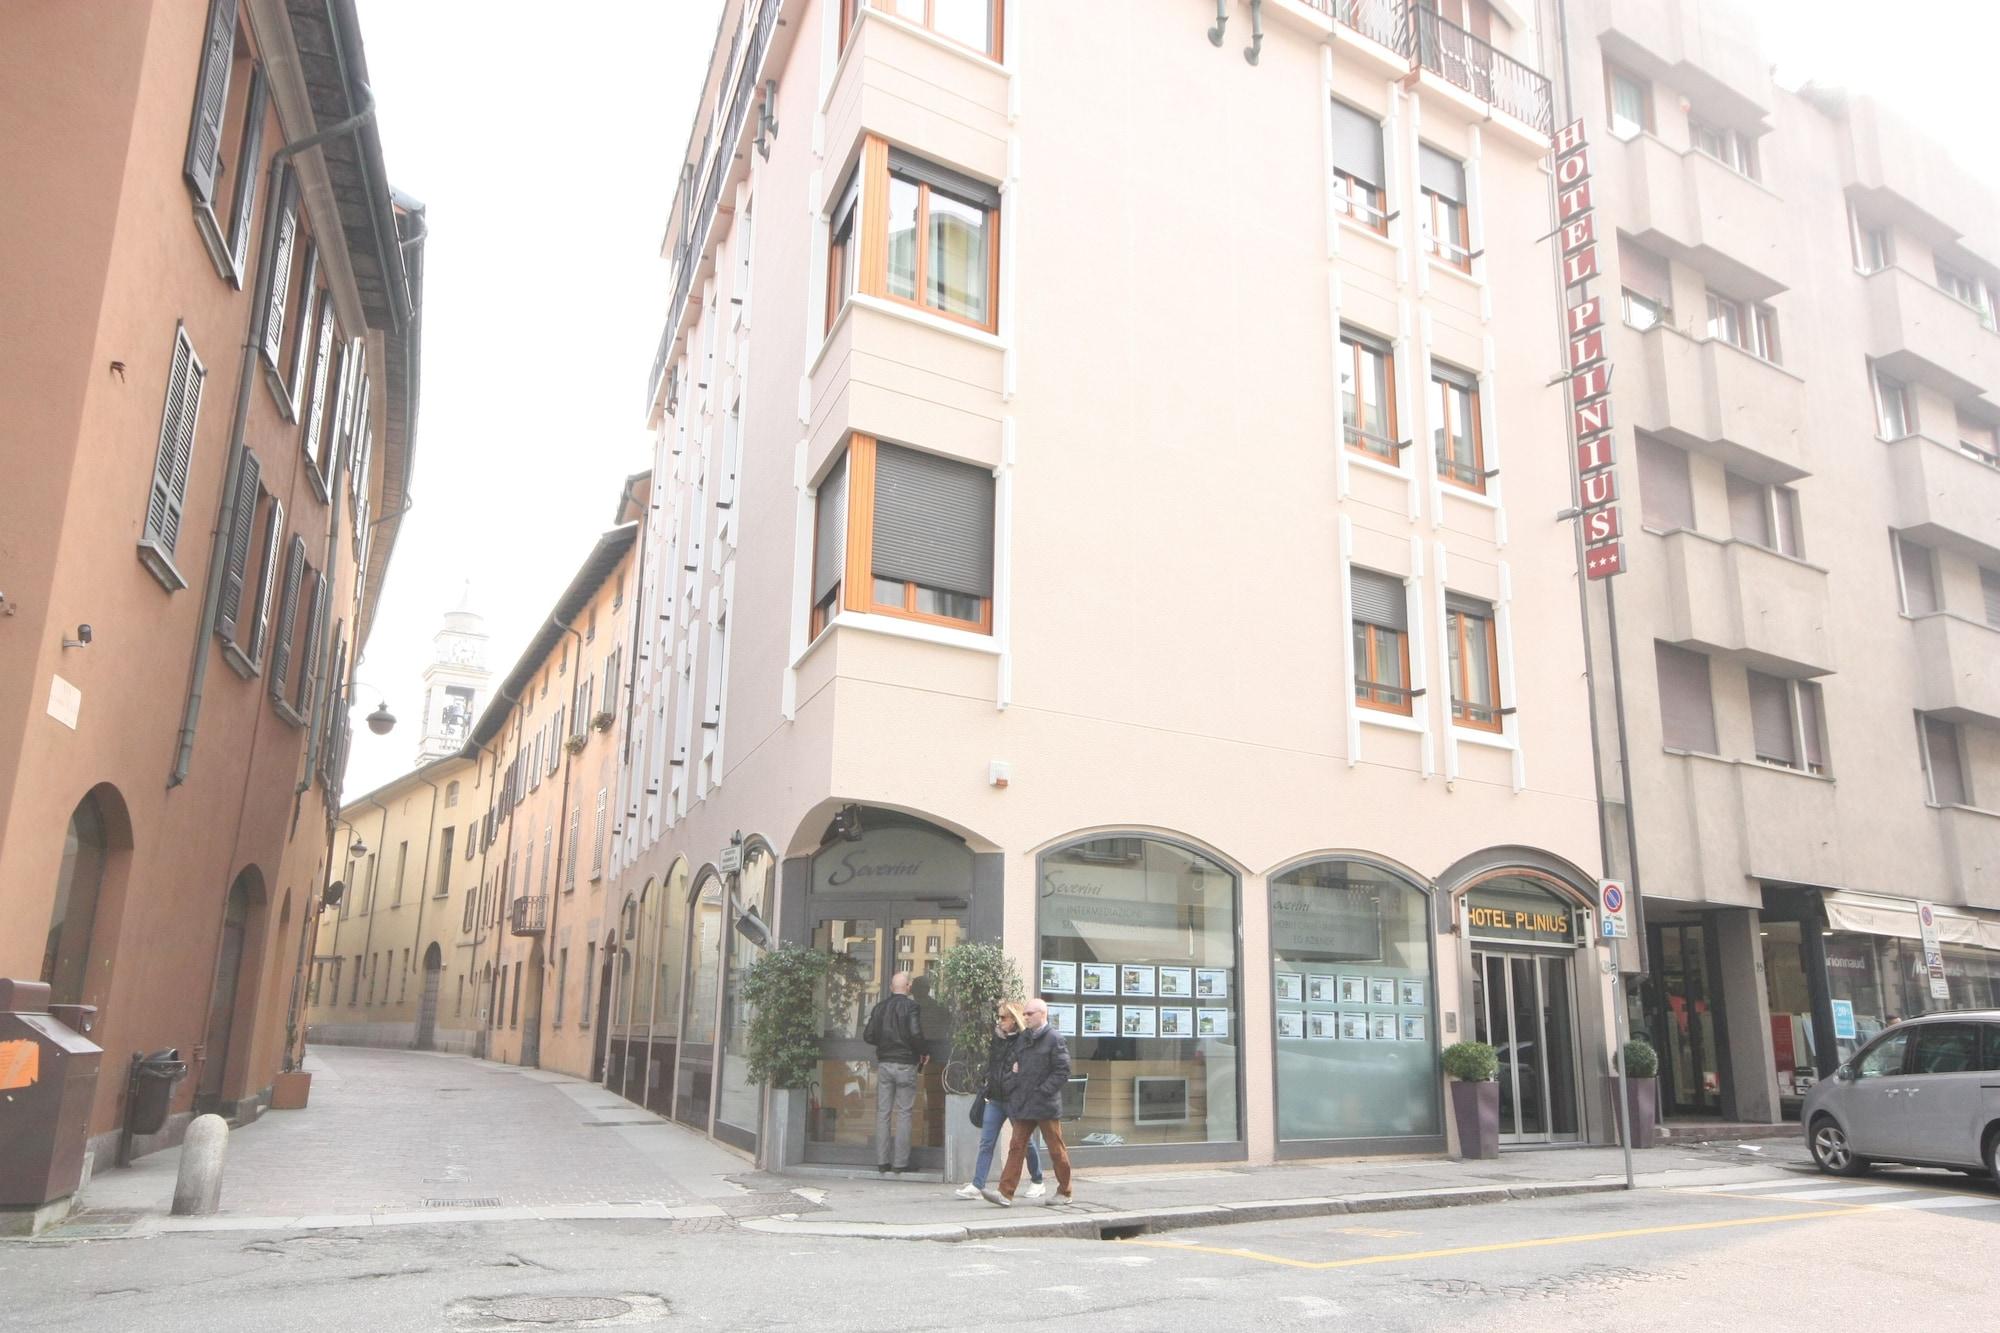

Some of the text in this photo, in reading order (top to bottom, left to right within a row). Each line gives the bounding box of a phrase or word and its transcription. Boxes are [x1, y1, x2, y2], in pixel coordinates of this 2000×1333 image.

[1556, 119, 1611, 541] HOTEL PLINIUS
[828, 848, 924, 886] Severini
[1041, 869, 1102, 898] Severini
[1469, 907, 1568, 933] HOTEL PLINIUS
